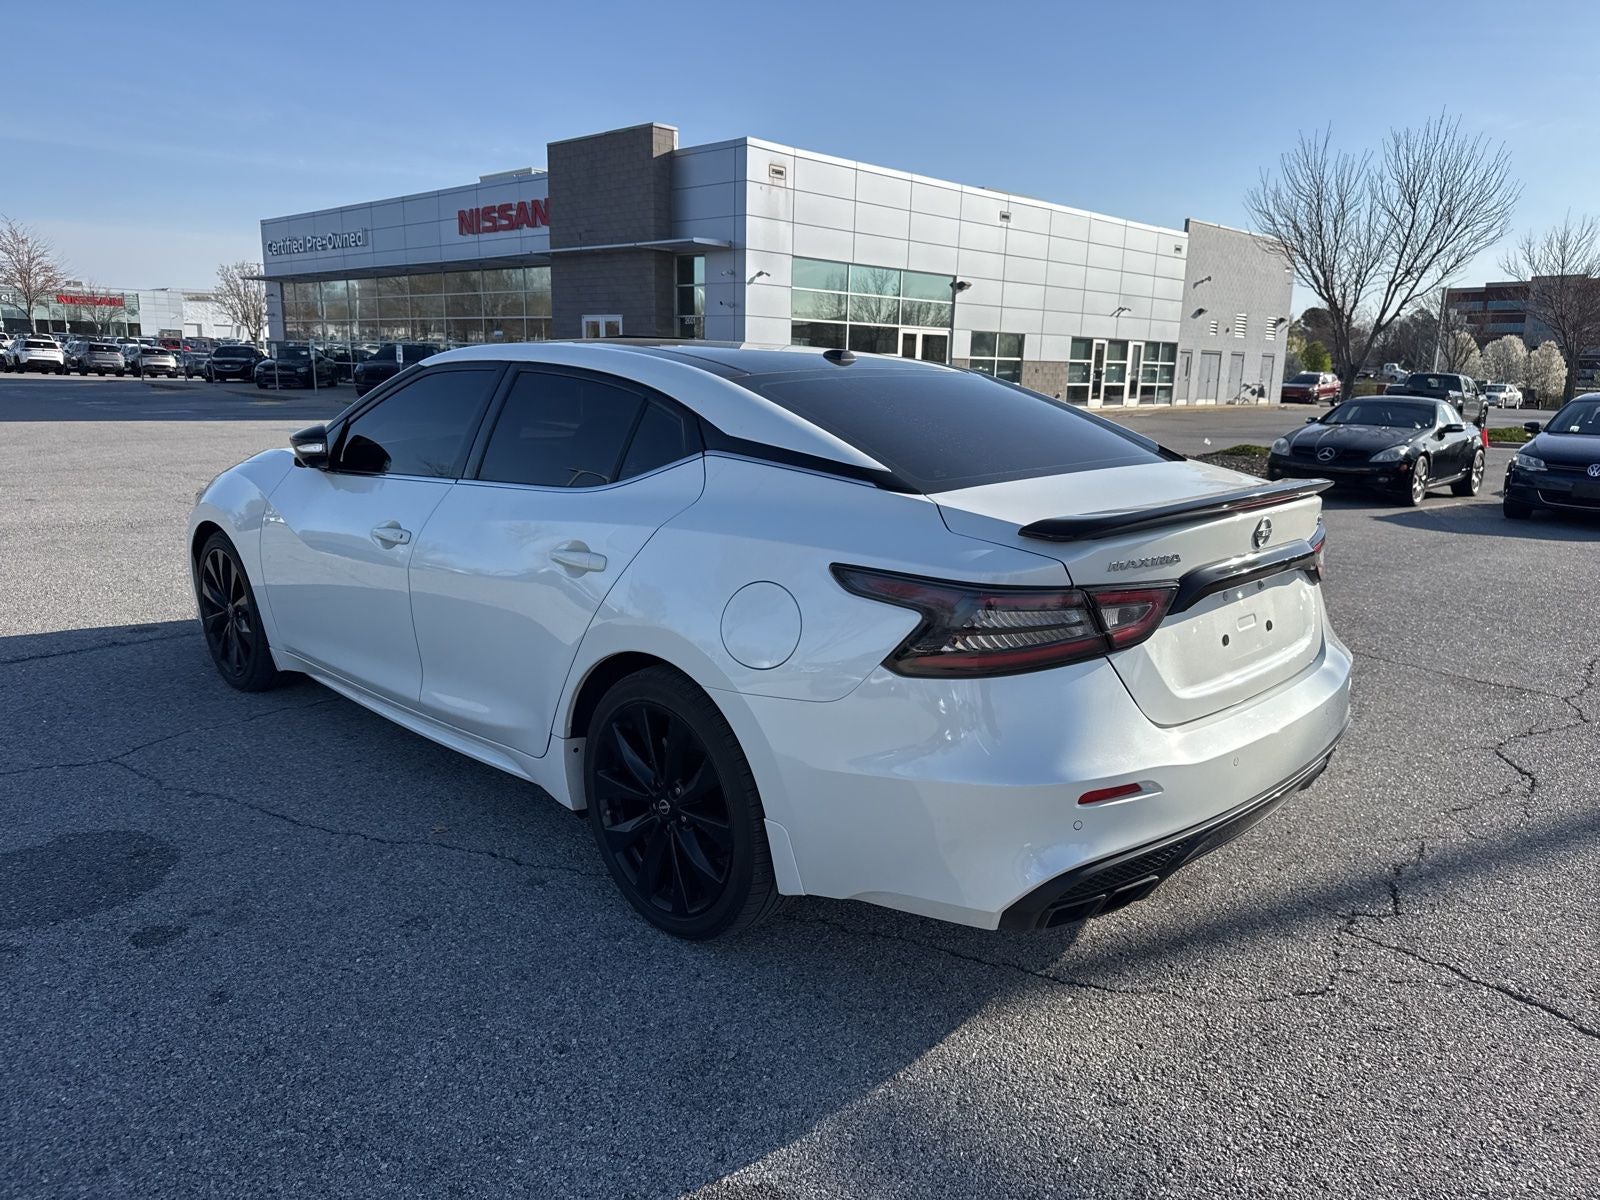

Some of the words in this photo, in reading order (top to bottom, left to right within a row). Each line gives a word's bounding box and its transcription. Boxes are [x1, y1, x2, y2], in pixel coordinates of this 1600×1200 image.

[458, 197, 551, 236] NISSAN
[267, 236, 304, 256] Certified
[306, 227, 364, 251] Pre-Owned
[1107, 554, 1181, 573] MAXIMA
